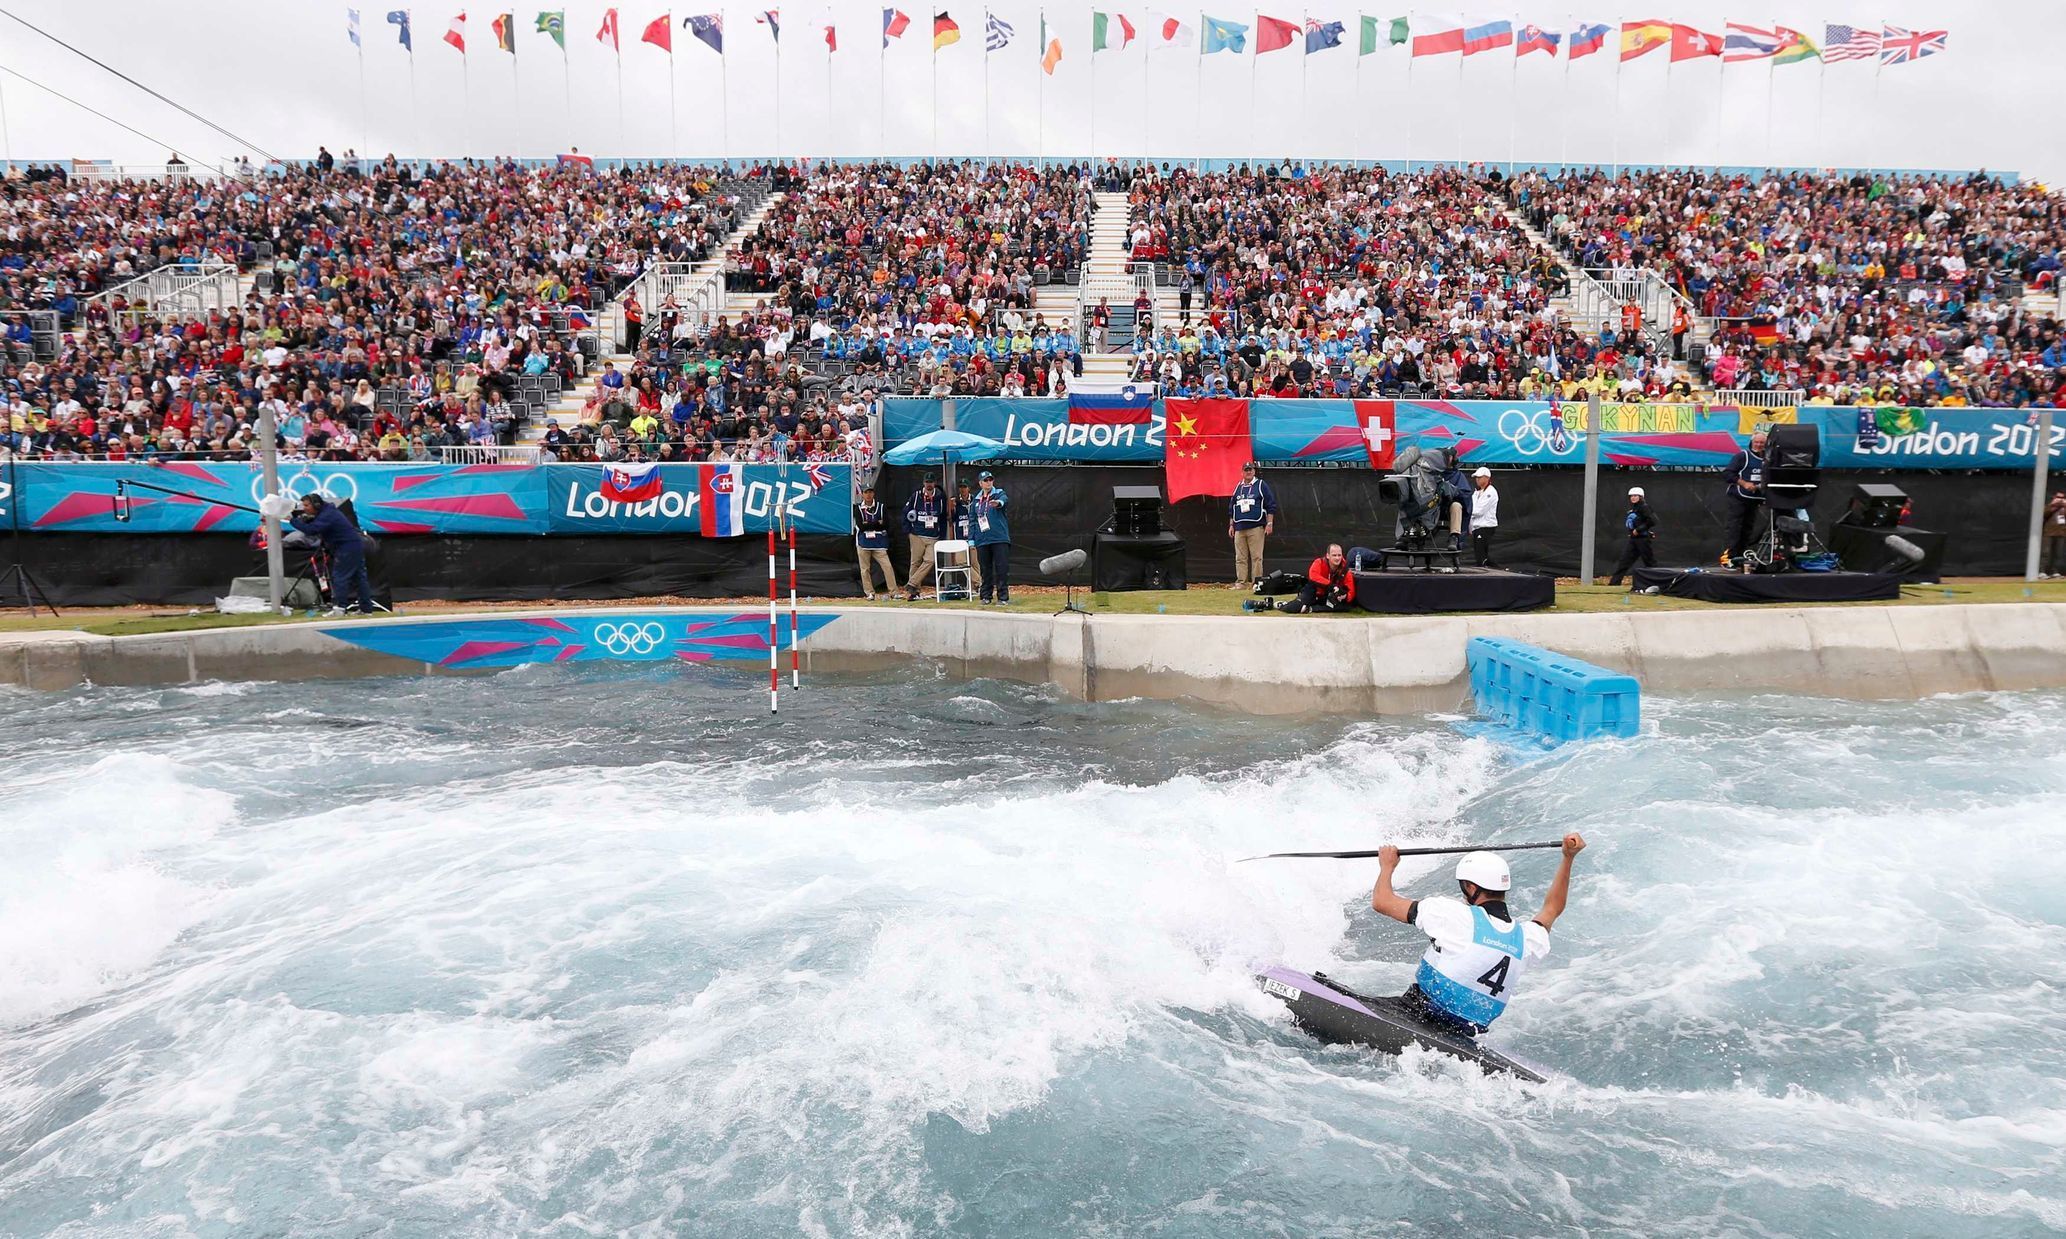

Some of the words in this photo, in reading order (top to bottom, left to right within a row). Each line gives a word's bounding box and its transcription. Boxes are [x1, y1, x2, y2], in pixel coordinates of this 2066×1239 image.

[1004, 414, 1135, 447] London
[742, 480, 812, 518] 012
[1483, 935, 1508, 950] London
[1477, 955, 1511, 997] 4
[1290, 988, 1297, 998] S
